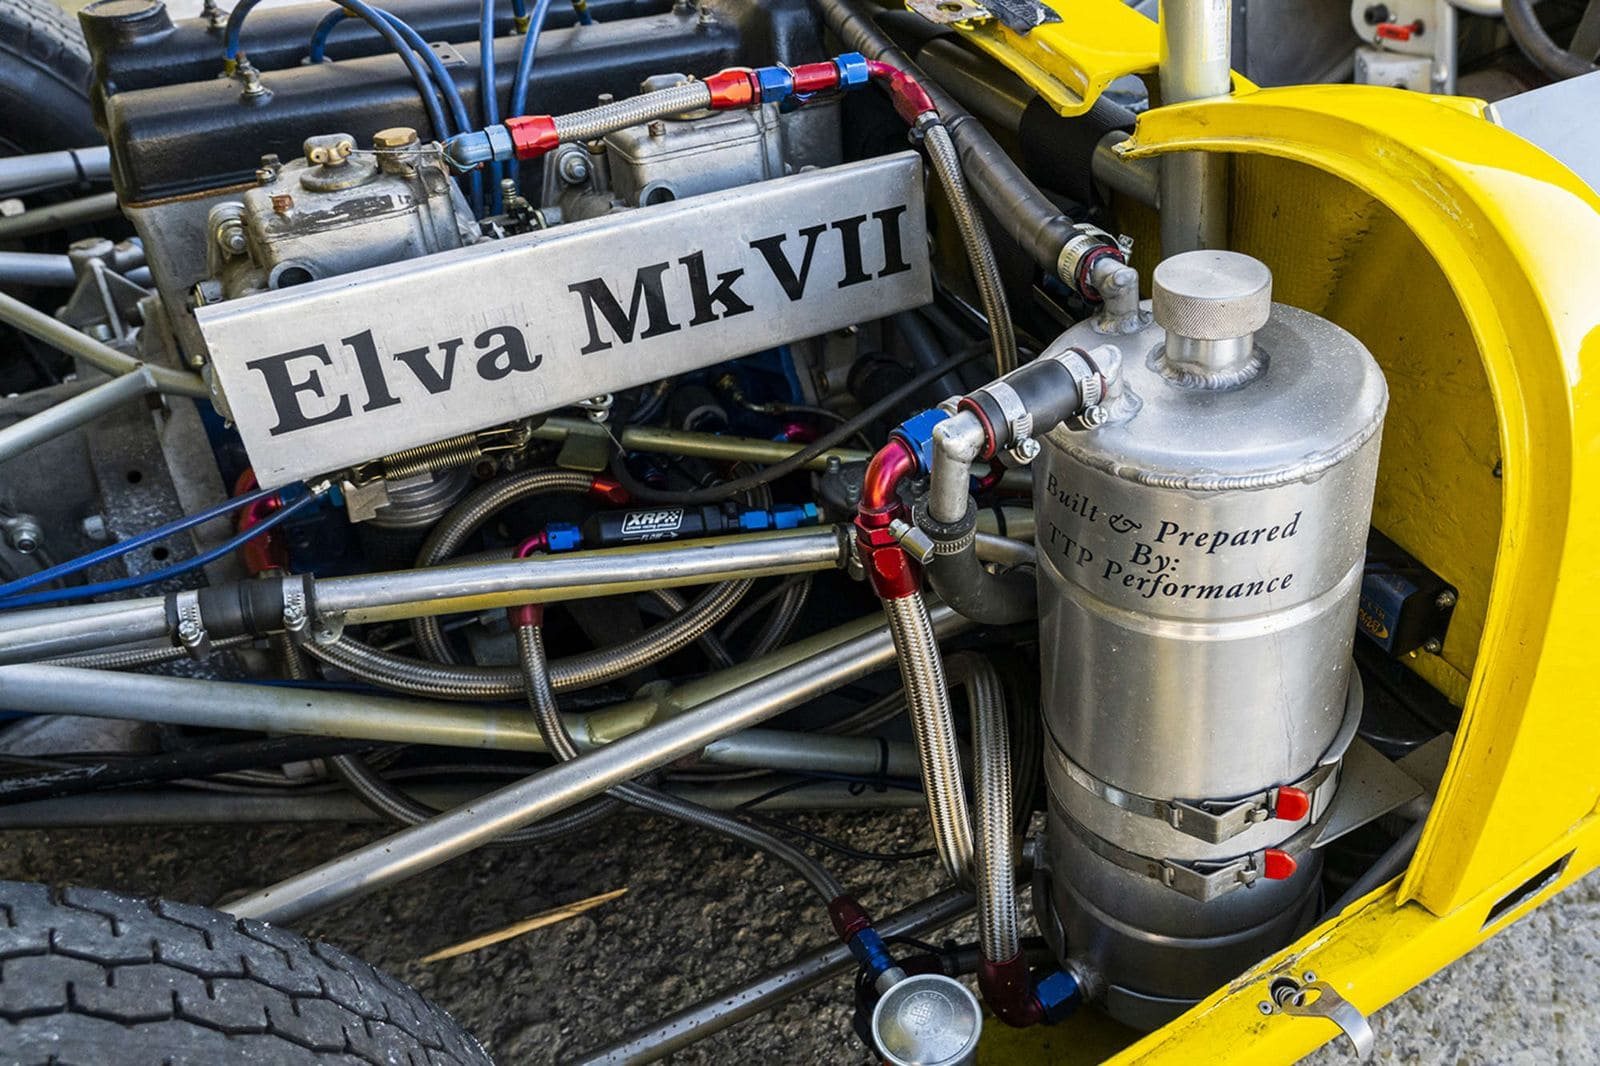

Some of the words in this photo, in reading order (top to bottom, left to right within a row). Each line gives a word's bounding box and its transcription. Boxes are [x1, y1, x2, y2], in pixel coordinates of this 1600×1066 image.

[247, 323, 542, 436] Elva
[627, 512, 669, 525] XRP
[1046, 474, 1099, 522] Built
[1108, 513, 1142, 534] &
[1155, 511, 1302, 554] Prepared
[1048, 522, 1094, 567] TTP
[1102, 559, 1293, 598] Performance
[1130, 542, 1180, 574] By:
